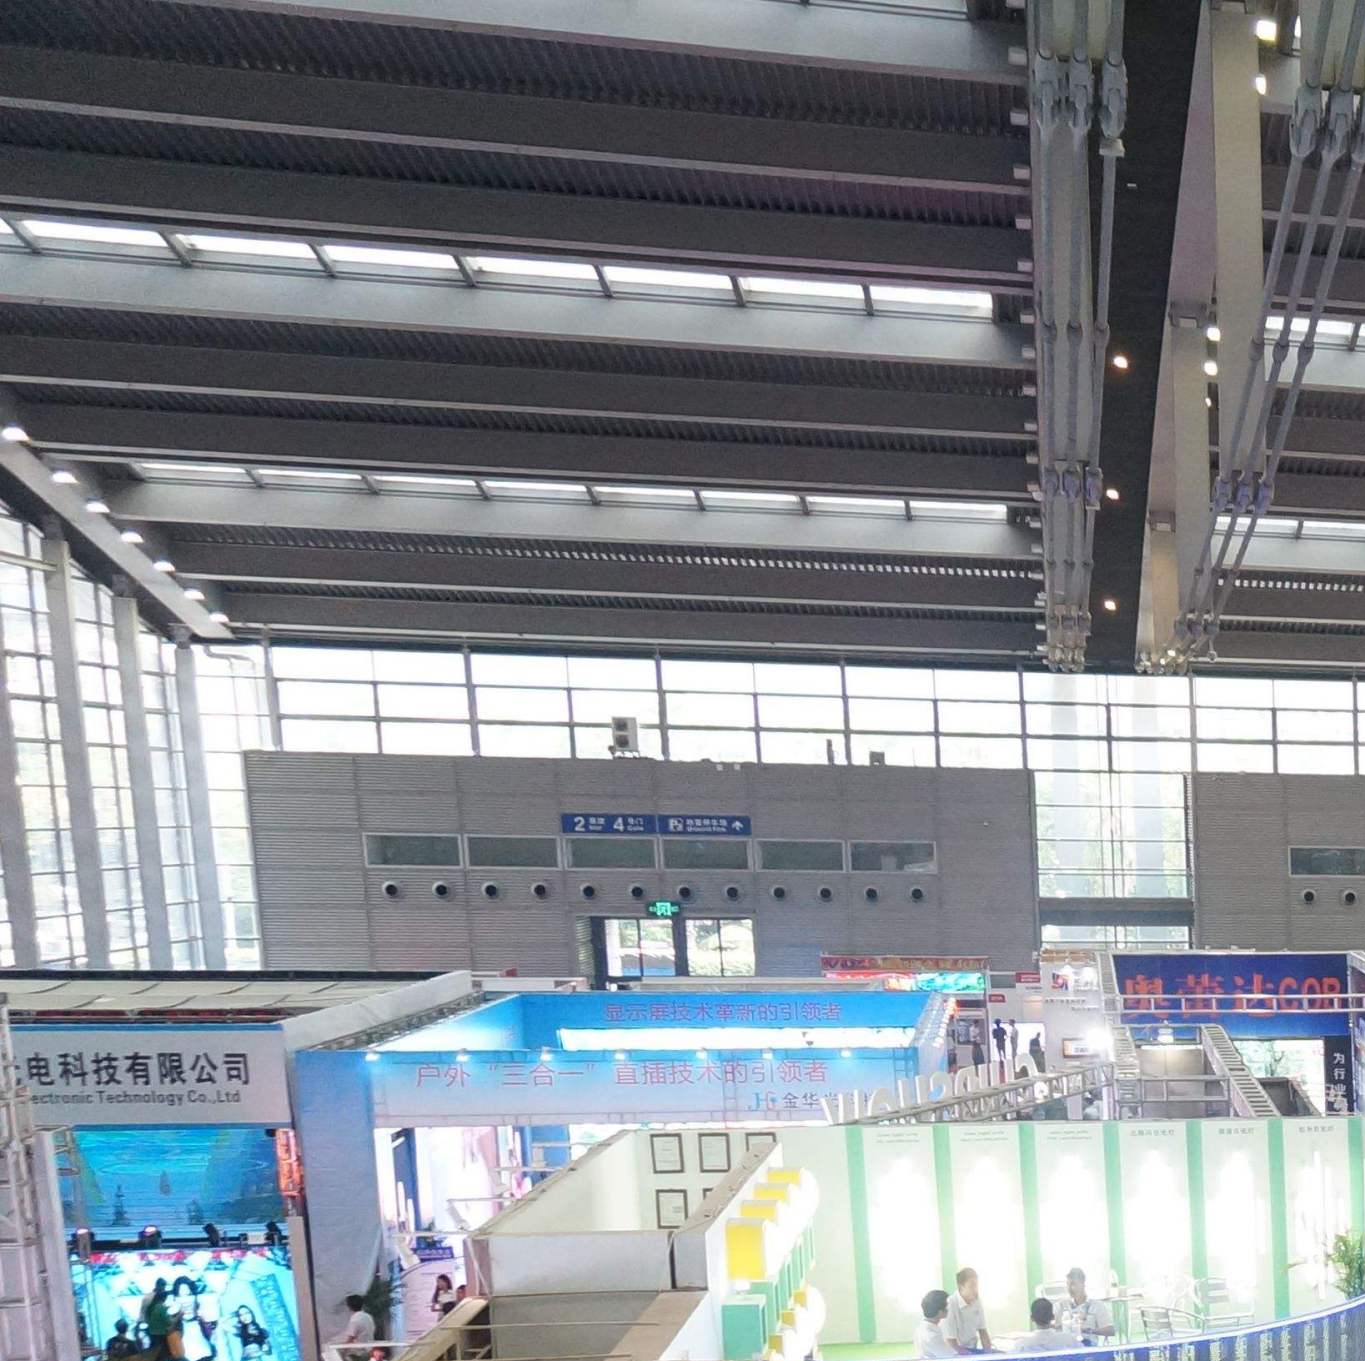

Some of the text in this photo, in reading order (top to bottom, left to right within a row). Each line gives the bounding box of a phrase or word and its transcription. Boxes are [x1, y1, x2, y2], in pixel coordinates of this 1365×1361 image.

[574, 816, 586, 832] 2
[612, 816, 625, 832] 4
[605, 1002, 842, 1024] 显示屏技术革新的引领者
[614, 1060, 830, 1085] 直插技术的引领者
[30, 1089, 94, 1105] ectronic
[96, 1089, 185, 1107] Technology
